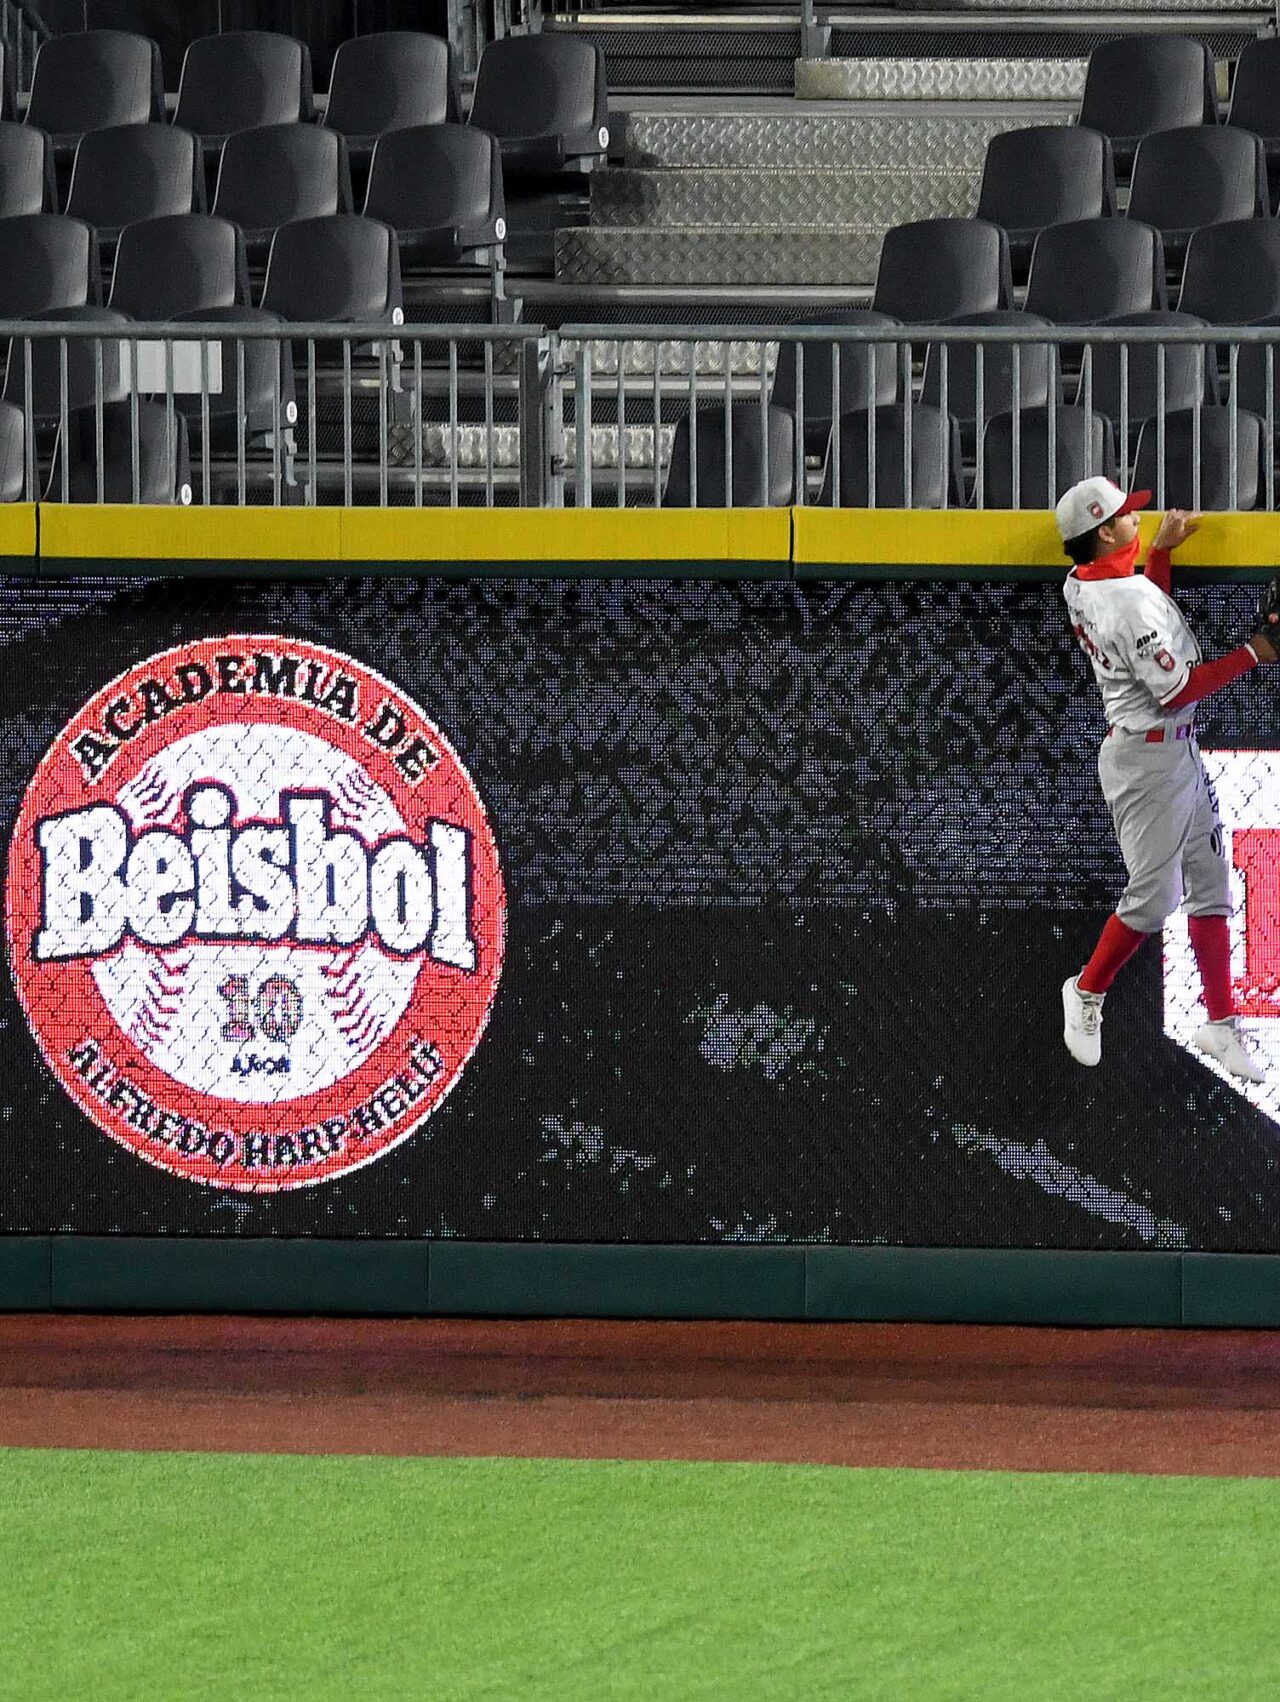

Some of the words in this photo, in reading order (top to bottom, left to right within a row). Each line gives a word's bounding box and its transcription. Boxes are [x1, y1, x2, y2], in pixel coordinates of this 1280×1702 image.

[71, 655, 360, 781] ACADEMIA
[365, 698, 441, 783] DE
[33, 781, 478, 974] Beisbol
[216, 972, 304, 1042] 10
[68, 1039, 235, 1164] ALFREDO
[242, 1117, 348, 1169] HARP
